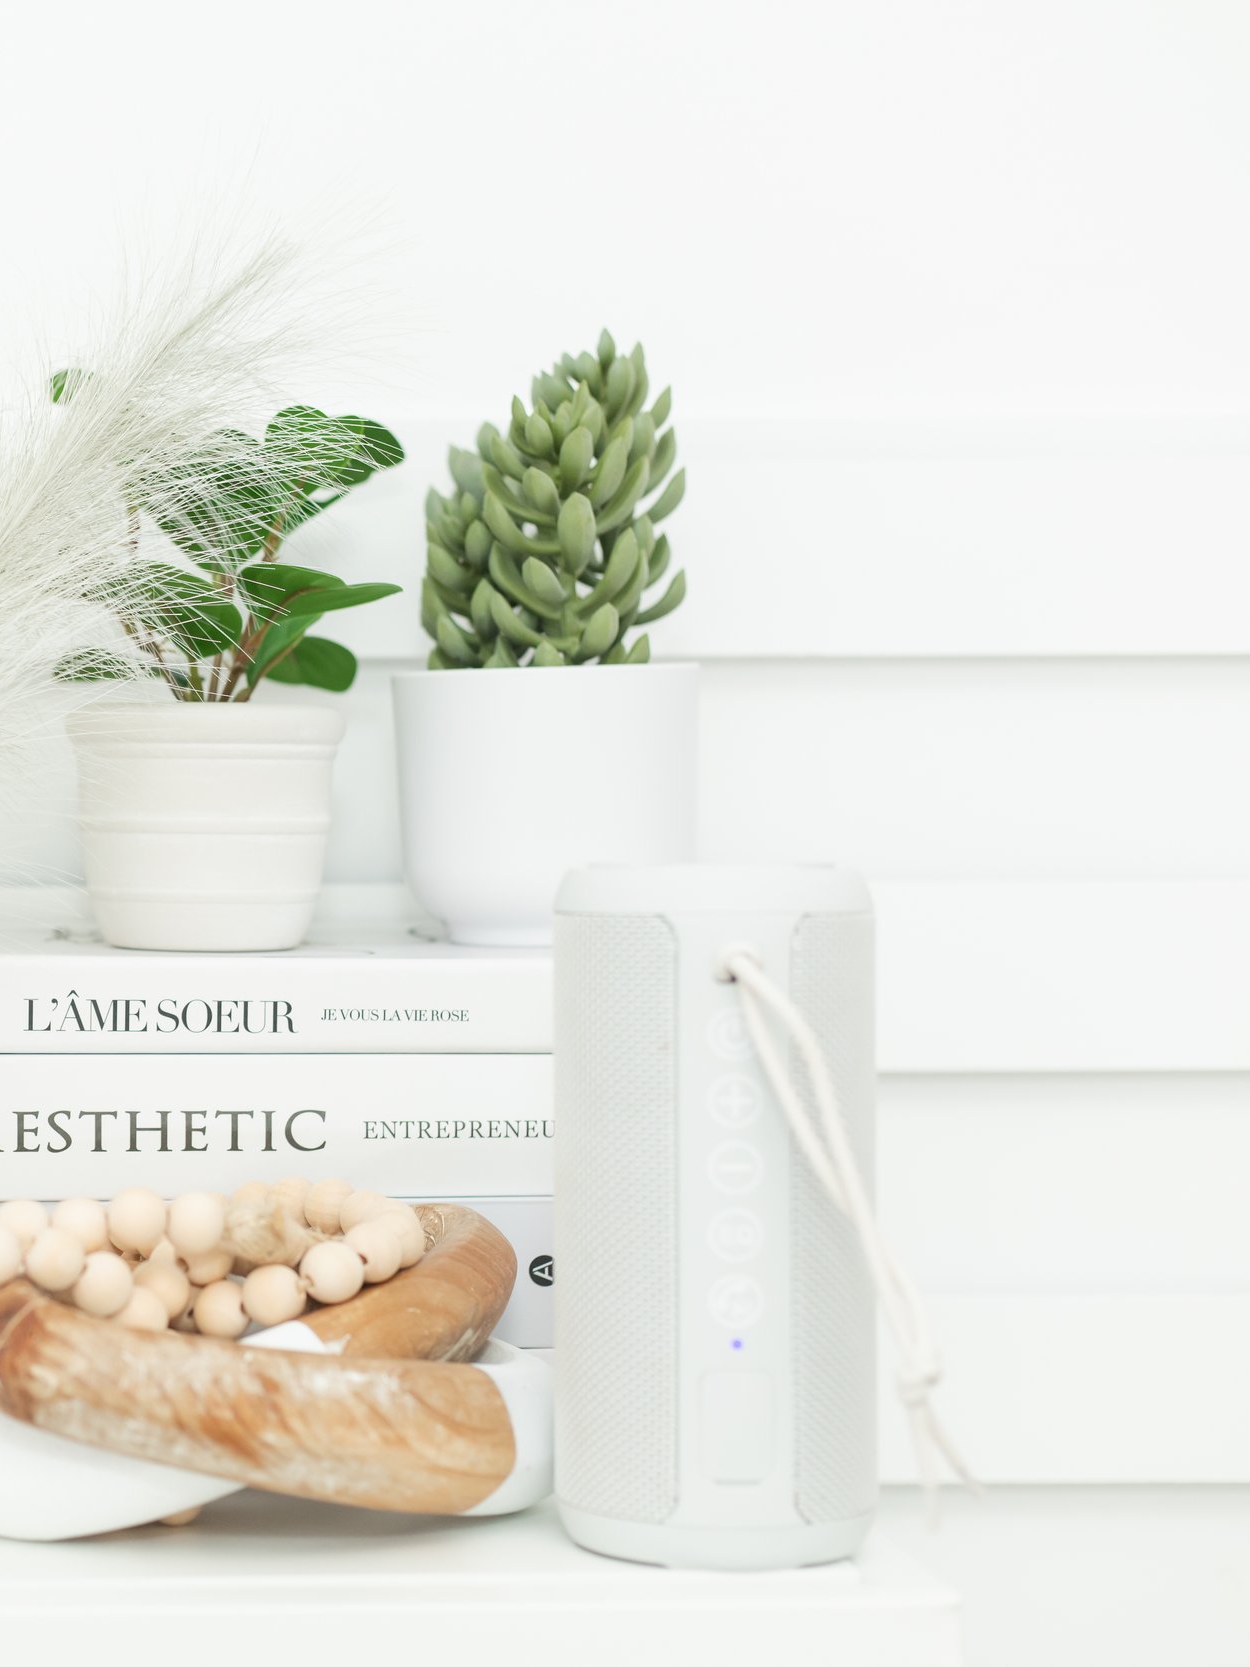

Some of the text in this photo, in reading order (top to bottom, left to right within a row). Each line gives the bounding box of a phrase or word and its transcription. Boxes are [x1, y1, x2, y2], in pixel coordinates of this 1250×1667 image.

[23, 989, 299, 1034] L’ÂME SOEUR
[321, 1008, 470, 1022] JE VOUS LA VIE ROSE
